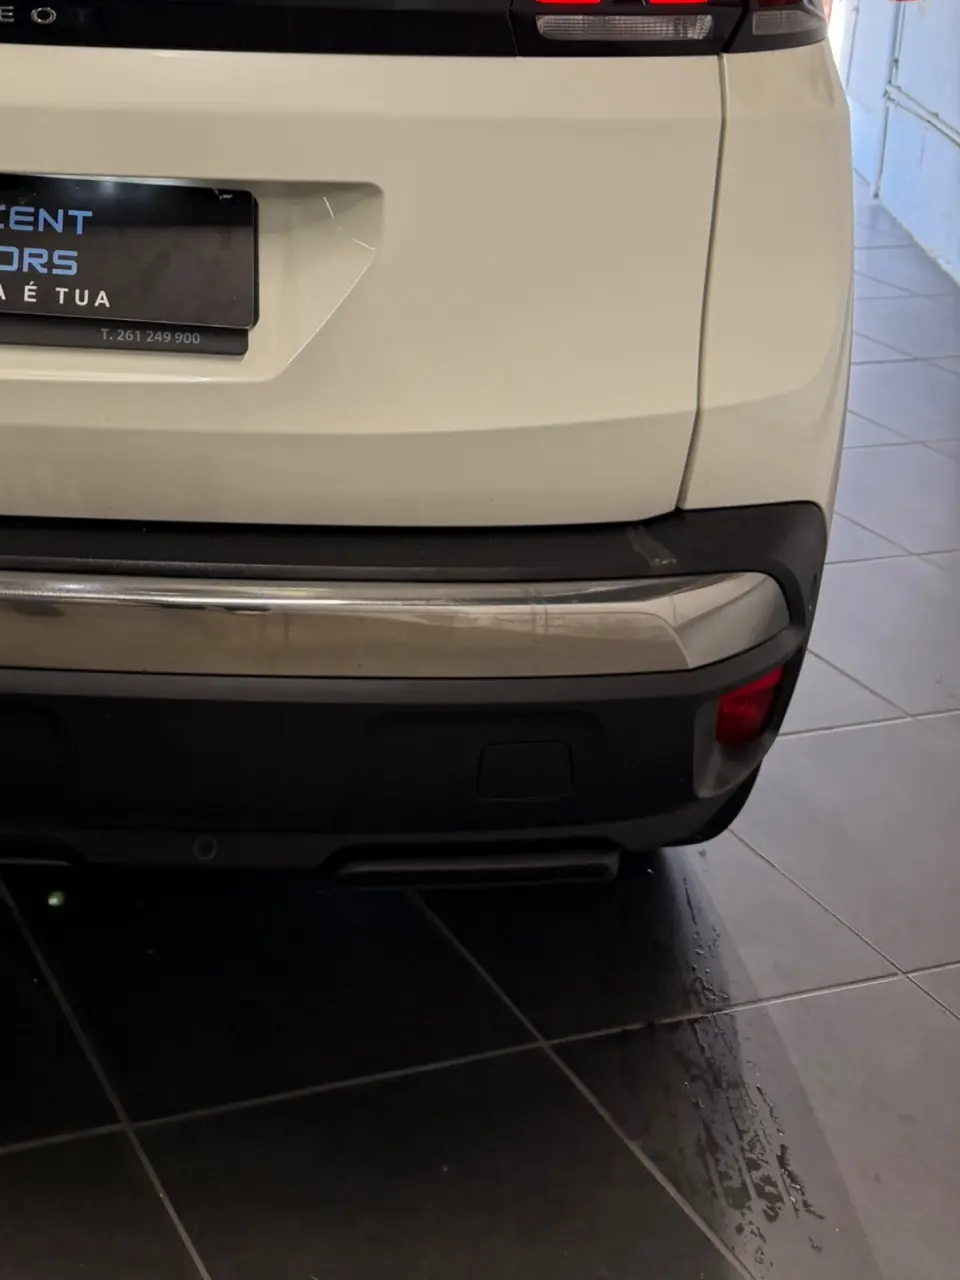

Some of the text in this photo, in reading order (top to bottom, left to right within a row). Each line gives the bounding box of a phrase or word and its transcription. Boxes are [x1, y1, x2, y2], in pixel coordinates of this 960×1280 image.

[23, 281, 38, 303] É
[55, 287, 111, 308] TUA
[101, 328, 200, 344] T. 261 249 900
